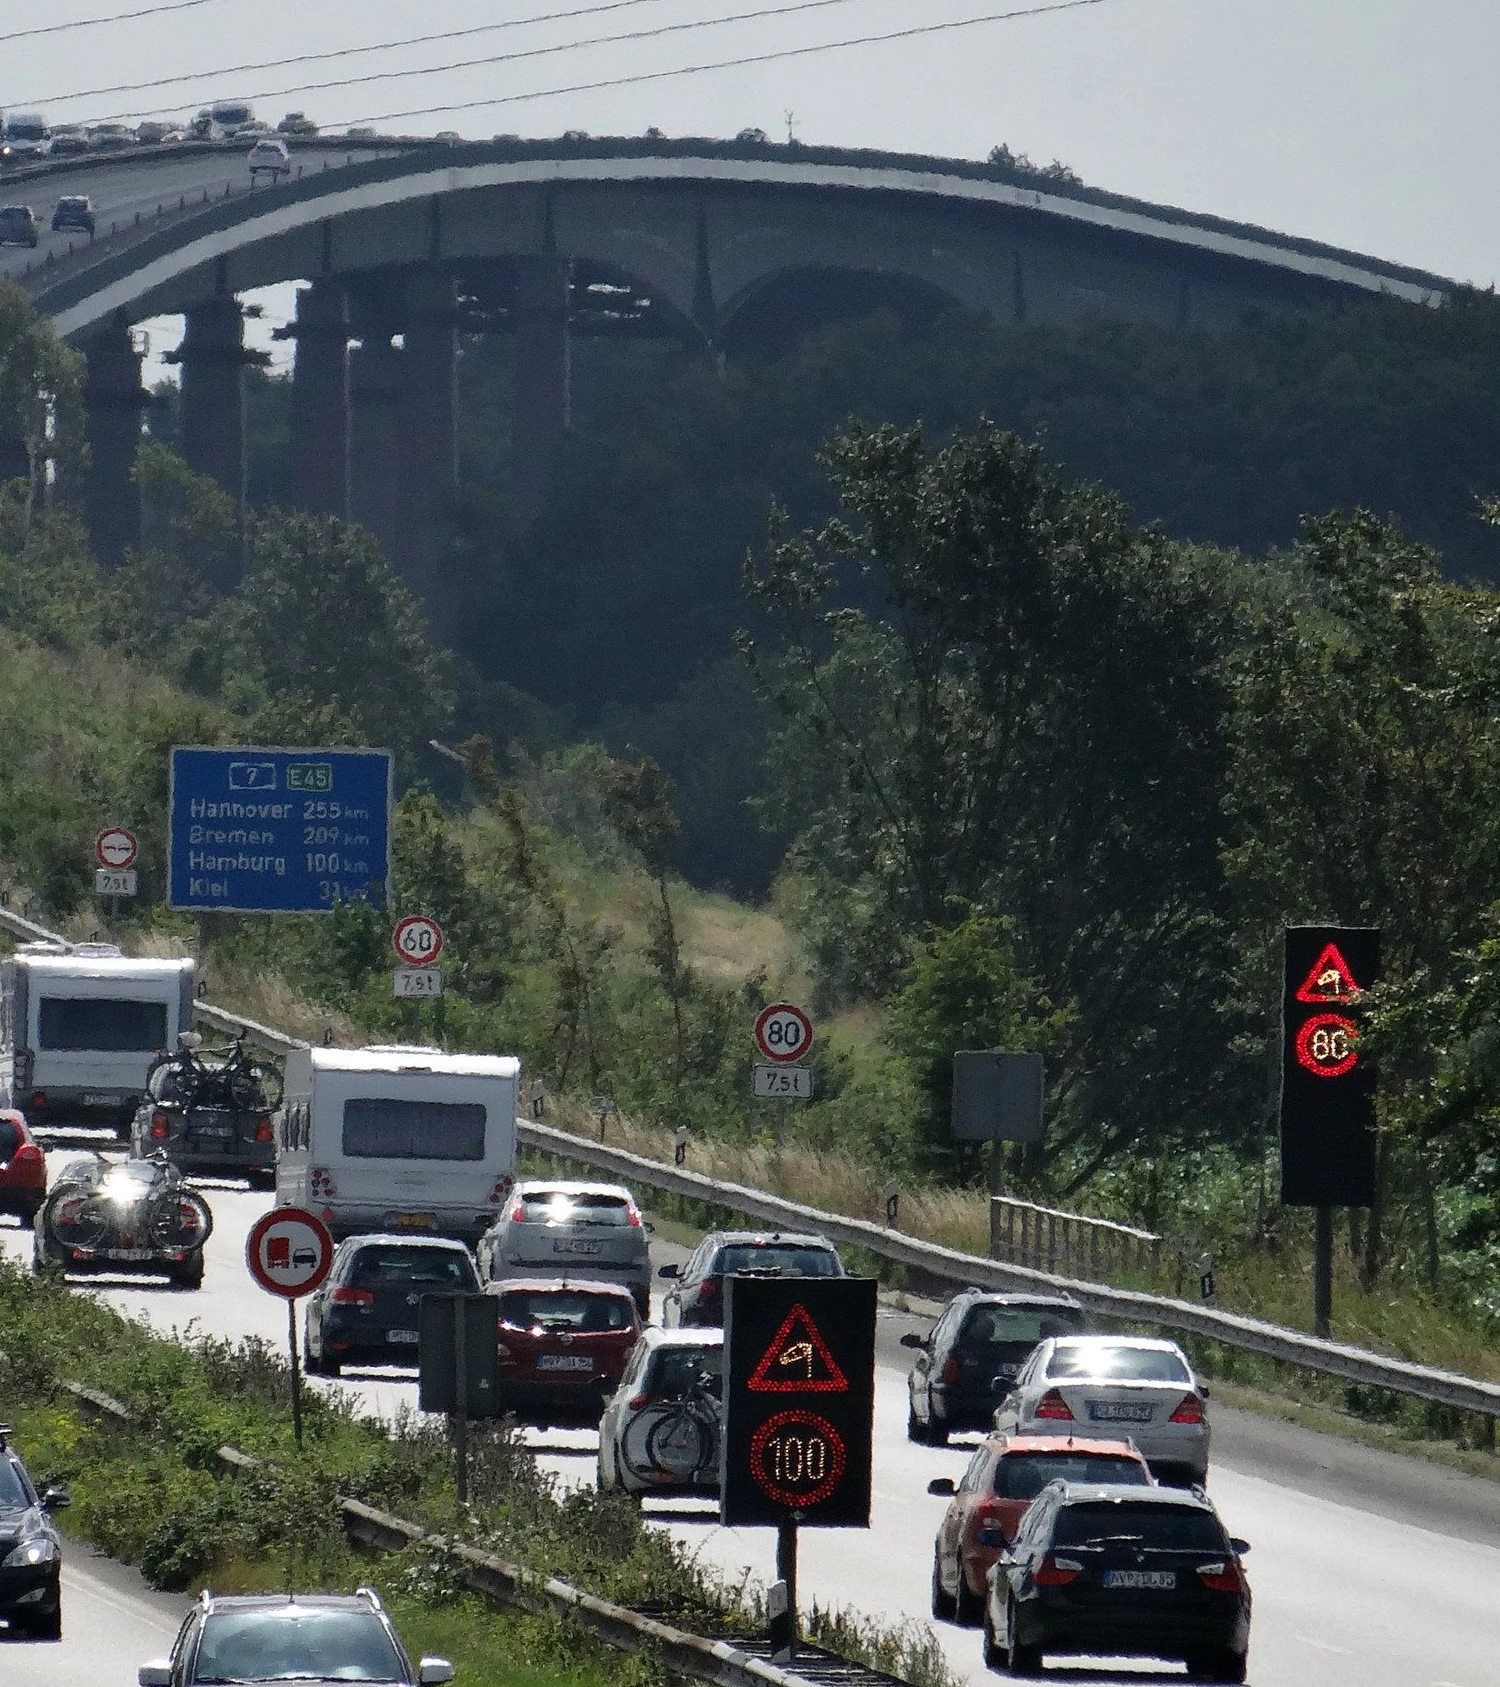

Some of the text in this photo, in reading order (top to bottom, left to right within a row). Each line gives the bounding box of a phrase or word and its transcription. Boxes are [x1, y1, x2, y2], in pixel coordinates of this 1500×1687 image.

[247, 767, 258, 785] 7
[190, 798, 369, 820] Hannover 255 km
[190, 825, 370, 846] Bremen 209 km
[189, 851, 369, 876] Hamburg 100 km
[190, 877, 229, 897] Kiel
[404, 928, 432, 952] 60
[767, 1020, 801, 1048] 80
[1312, 1029, 1349, 1060] 80
[768, 1437, 825, 1481] 100
